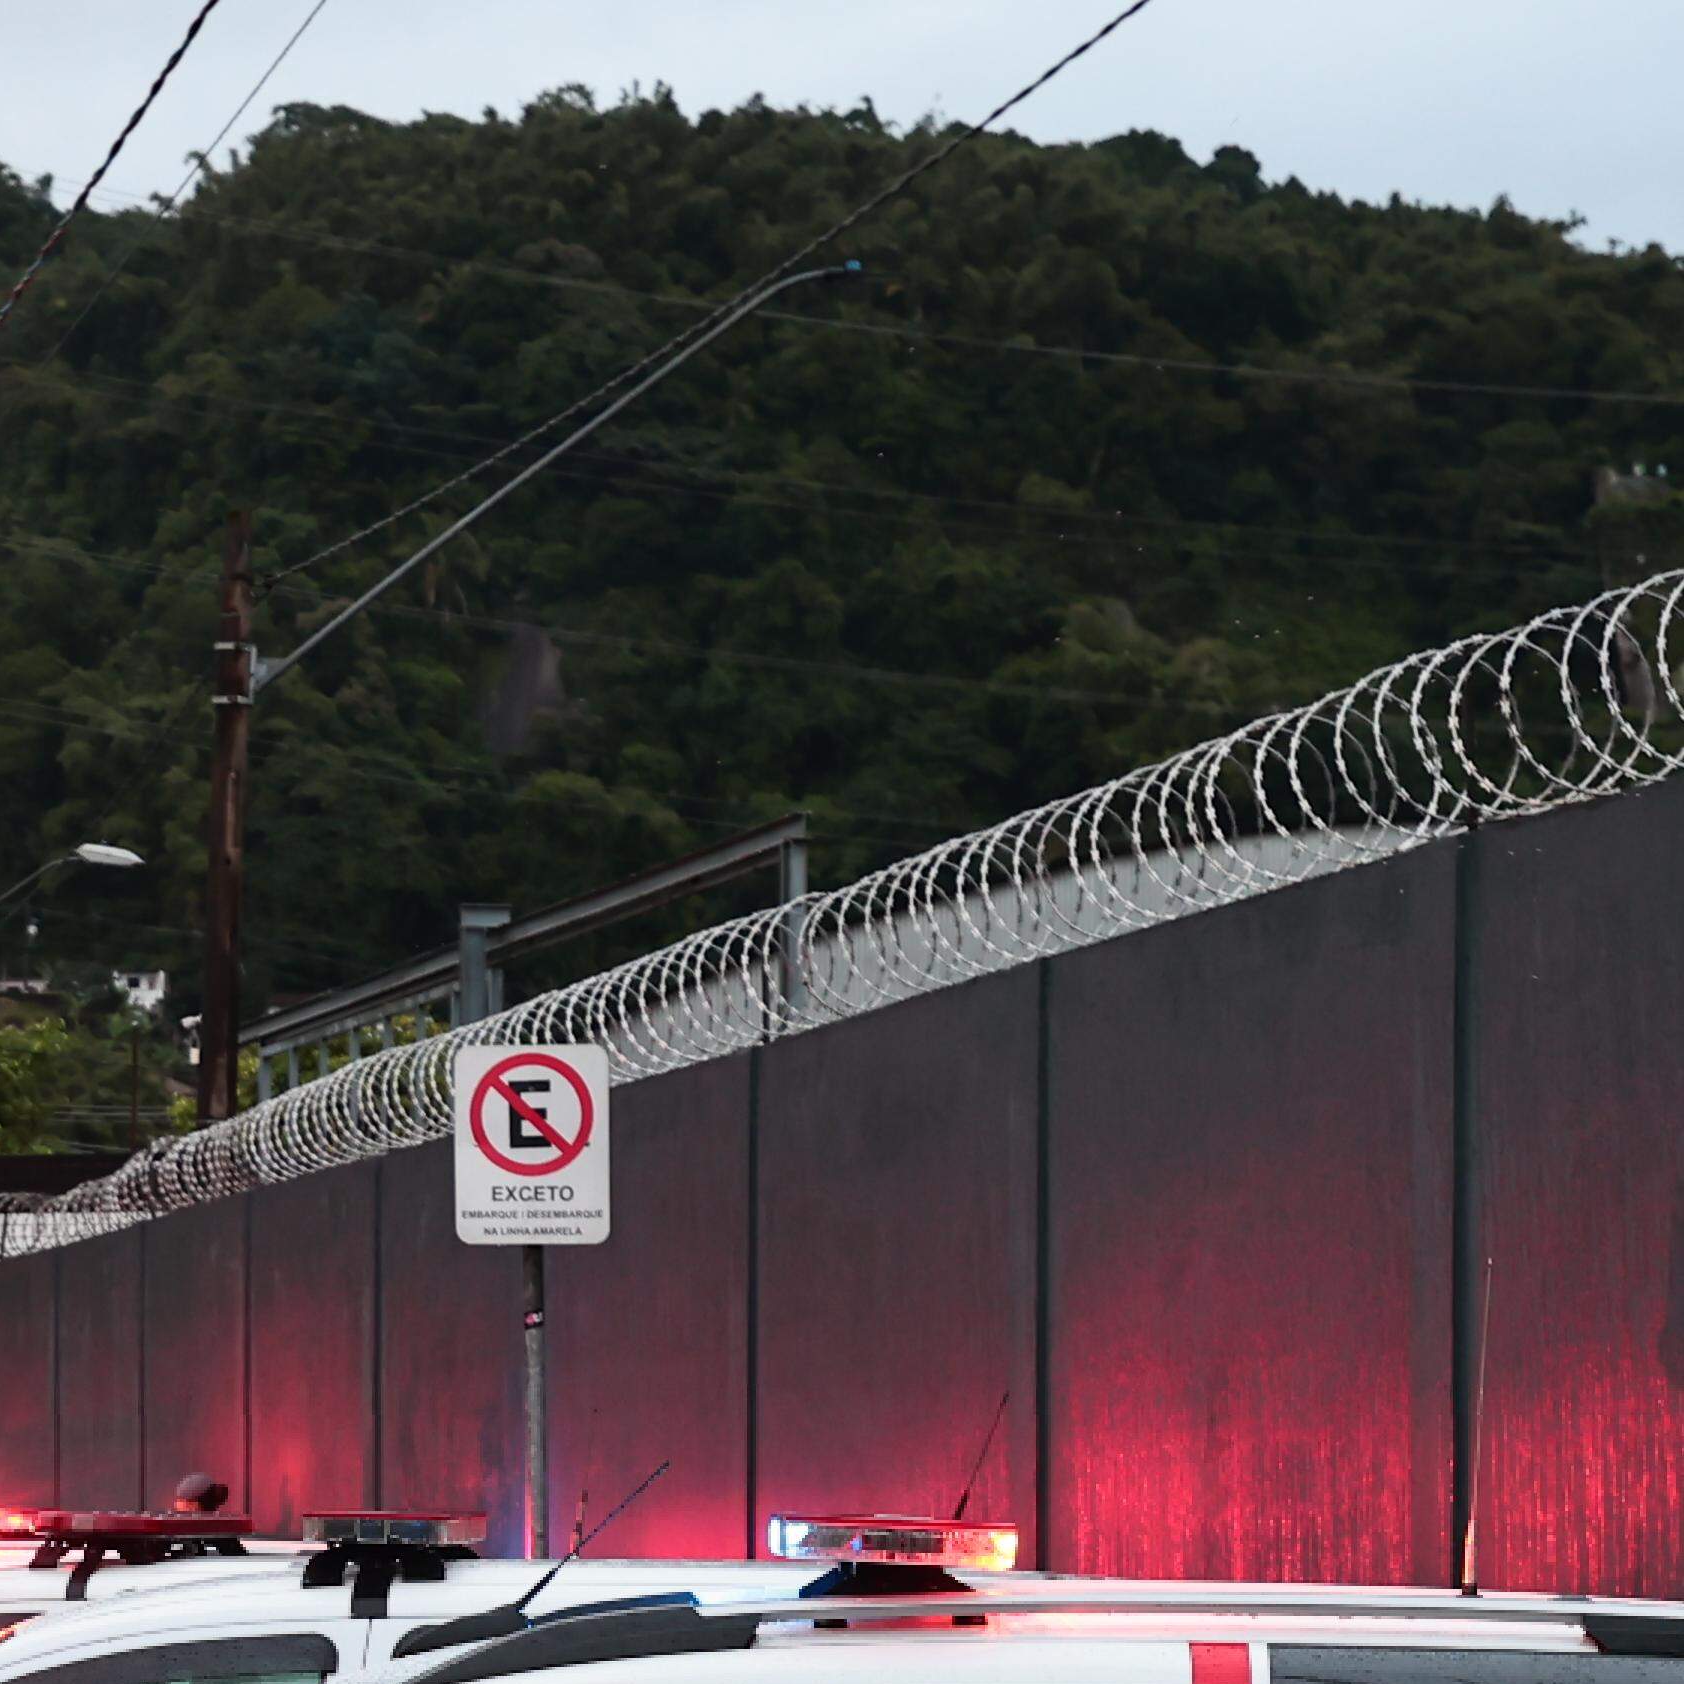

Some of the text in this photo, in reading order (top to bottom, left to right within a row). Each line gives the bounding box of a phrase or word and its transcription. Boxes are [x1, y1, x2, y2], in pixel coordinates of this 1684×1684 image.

[509, 1079, 551, 1149] E
[491, 1185, 575, 1202] EXCETO
[461, 1210, 518, 1219] EMBARQUE
[527, 1209, 603, 1219] DESEMBARQUE
[483, 1226, 583, 1236] NA LINHA AMARELA
